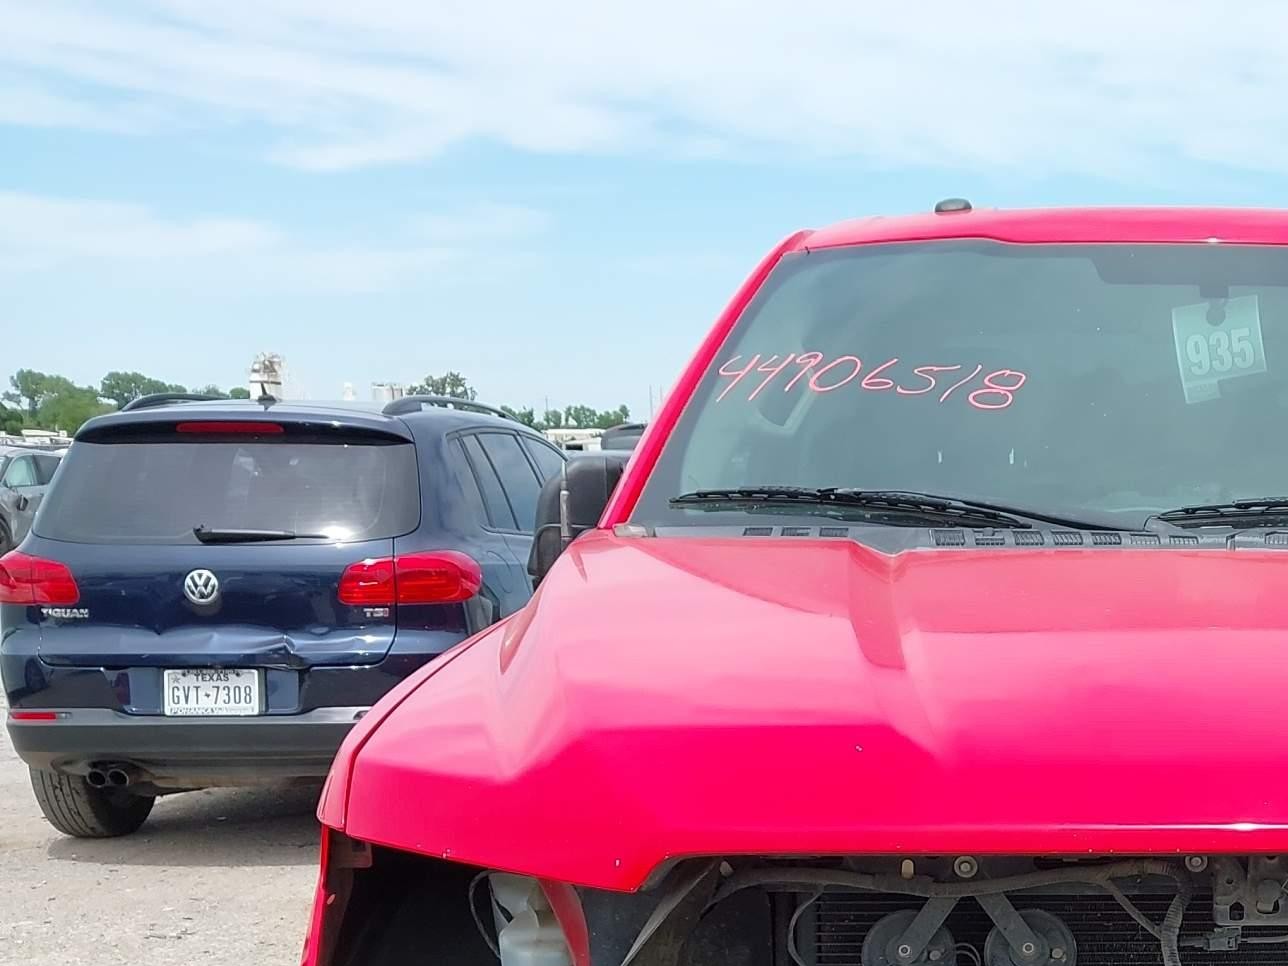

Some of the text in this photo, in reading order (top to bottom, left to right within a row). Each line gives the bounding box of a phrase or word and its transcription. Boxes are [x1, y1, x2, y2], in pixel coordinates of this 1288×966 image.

[1185, 327, 1256, 376] 935
[715, 351, 1027, 410] 44906518
[40, 607, 89, 619] TIGUAN
[363, 607, 389, 618] TSI
[194, 673, 230, 682] TEXAS
[172, 685, 252, 705] GVT 7308
